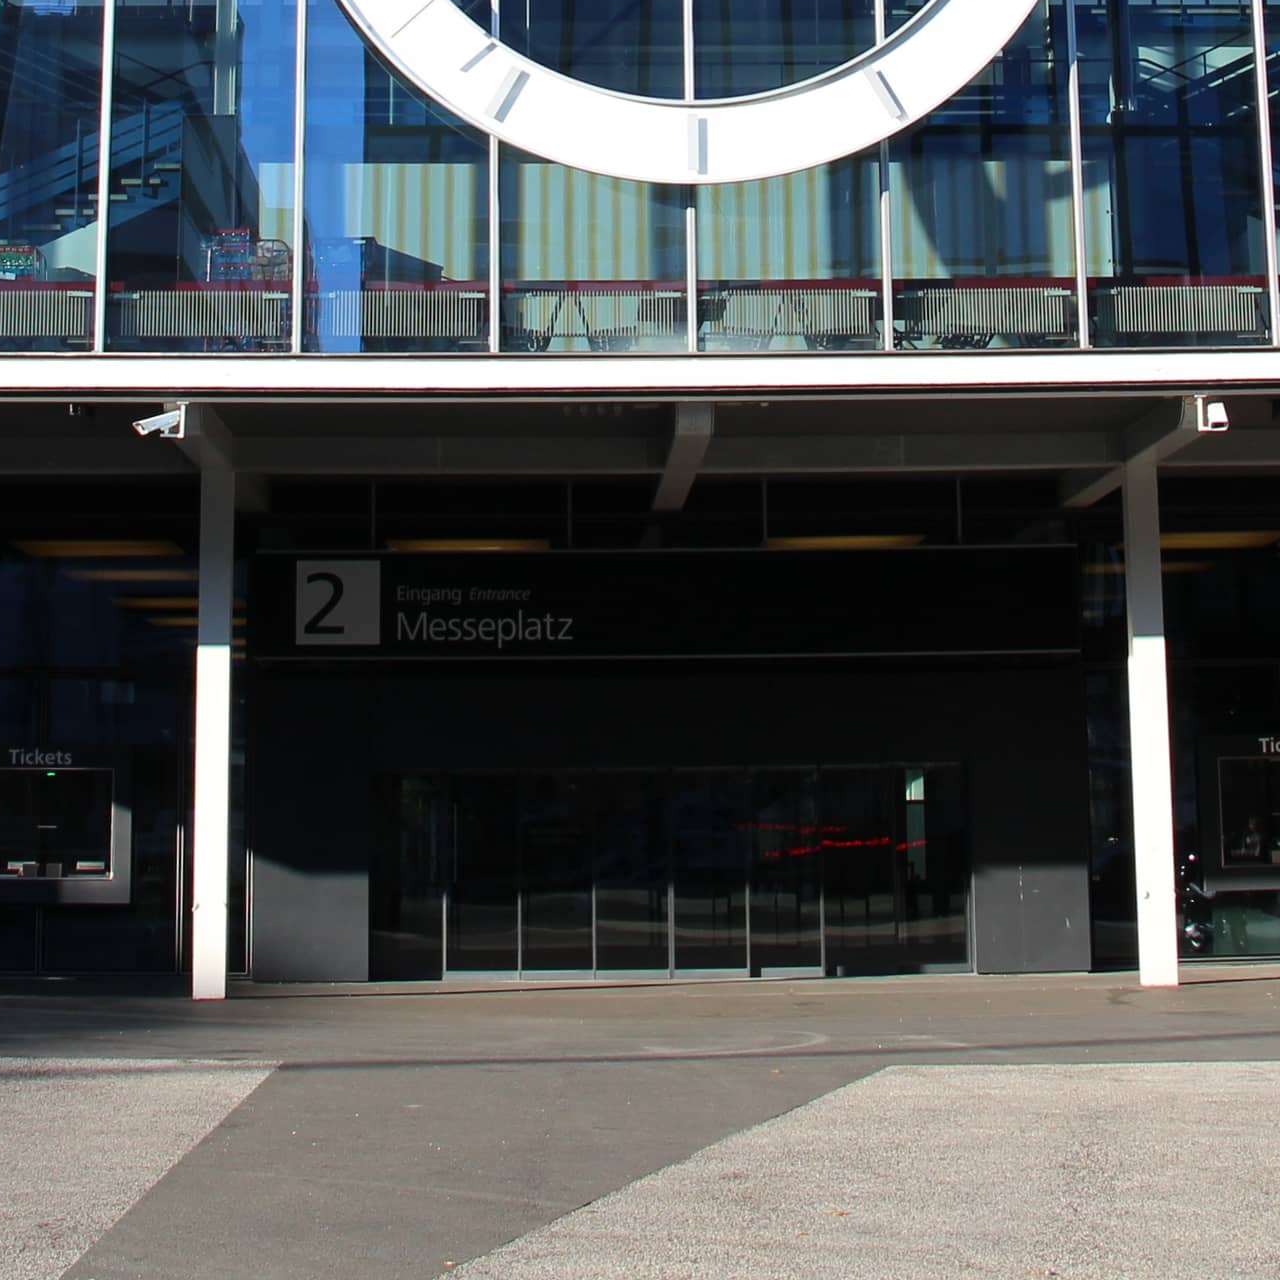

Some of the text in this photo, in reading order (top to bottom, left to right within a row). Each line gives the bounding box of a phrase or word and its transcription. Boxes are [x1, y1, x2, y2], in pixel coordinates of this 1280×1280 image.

[303, 572, 345, 635] 2
[396, 584, 531, 605] Eingang Entrance
[396, 610, 574, 648] Messeplatz
[8, 747, 73, 765] Tickets
